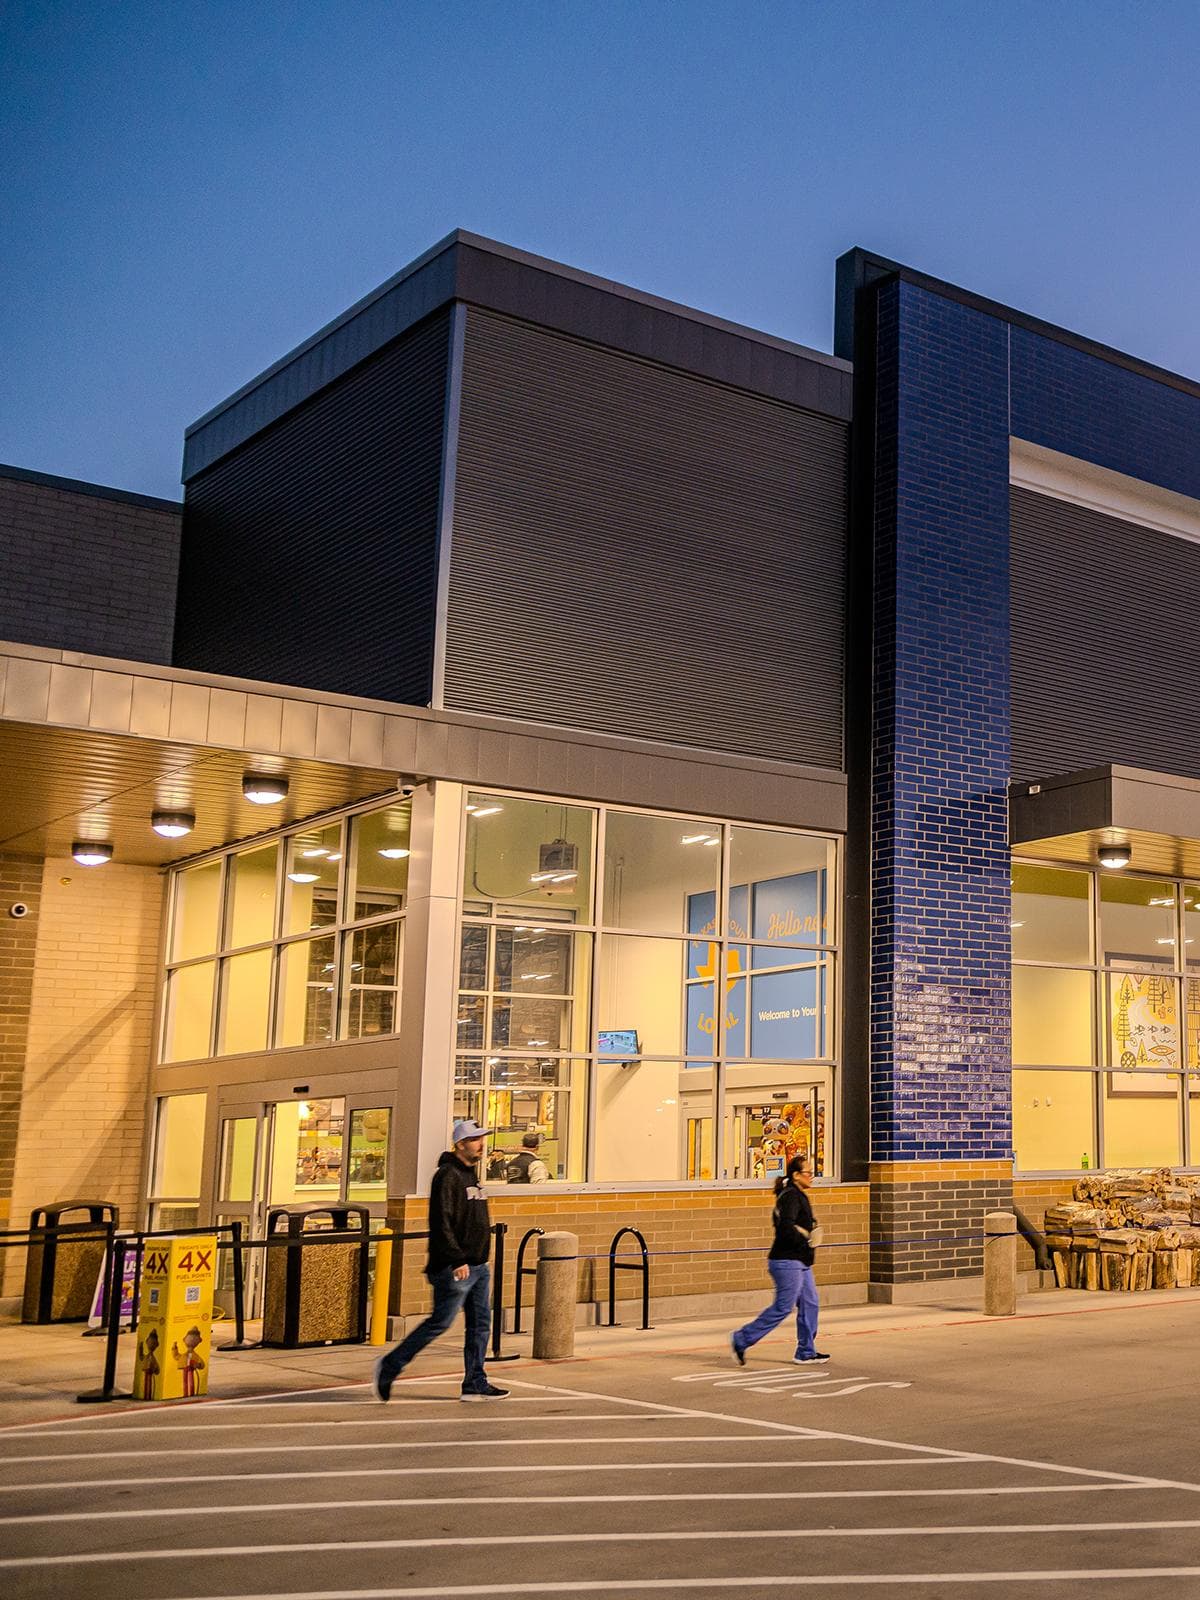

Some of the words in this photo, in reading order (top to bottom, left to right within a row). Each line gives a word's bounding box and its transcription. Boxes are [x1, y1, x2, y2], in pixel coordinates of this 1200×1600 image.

[767, 910, 801, 939] Hello
[758, 1009, 790, 1021] Welcome
[792, 1008, 800, 1017] to
[146, 1252, 168, 1274] 4X
[178, 1250, 211, 1272] 4X
